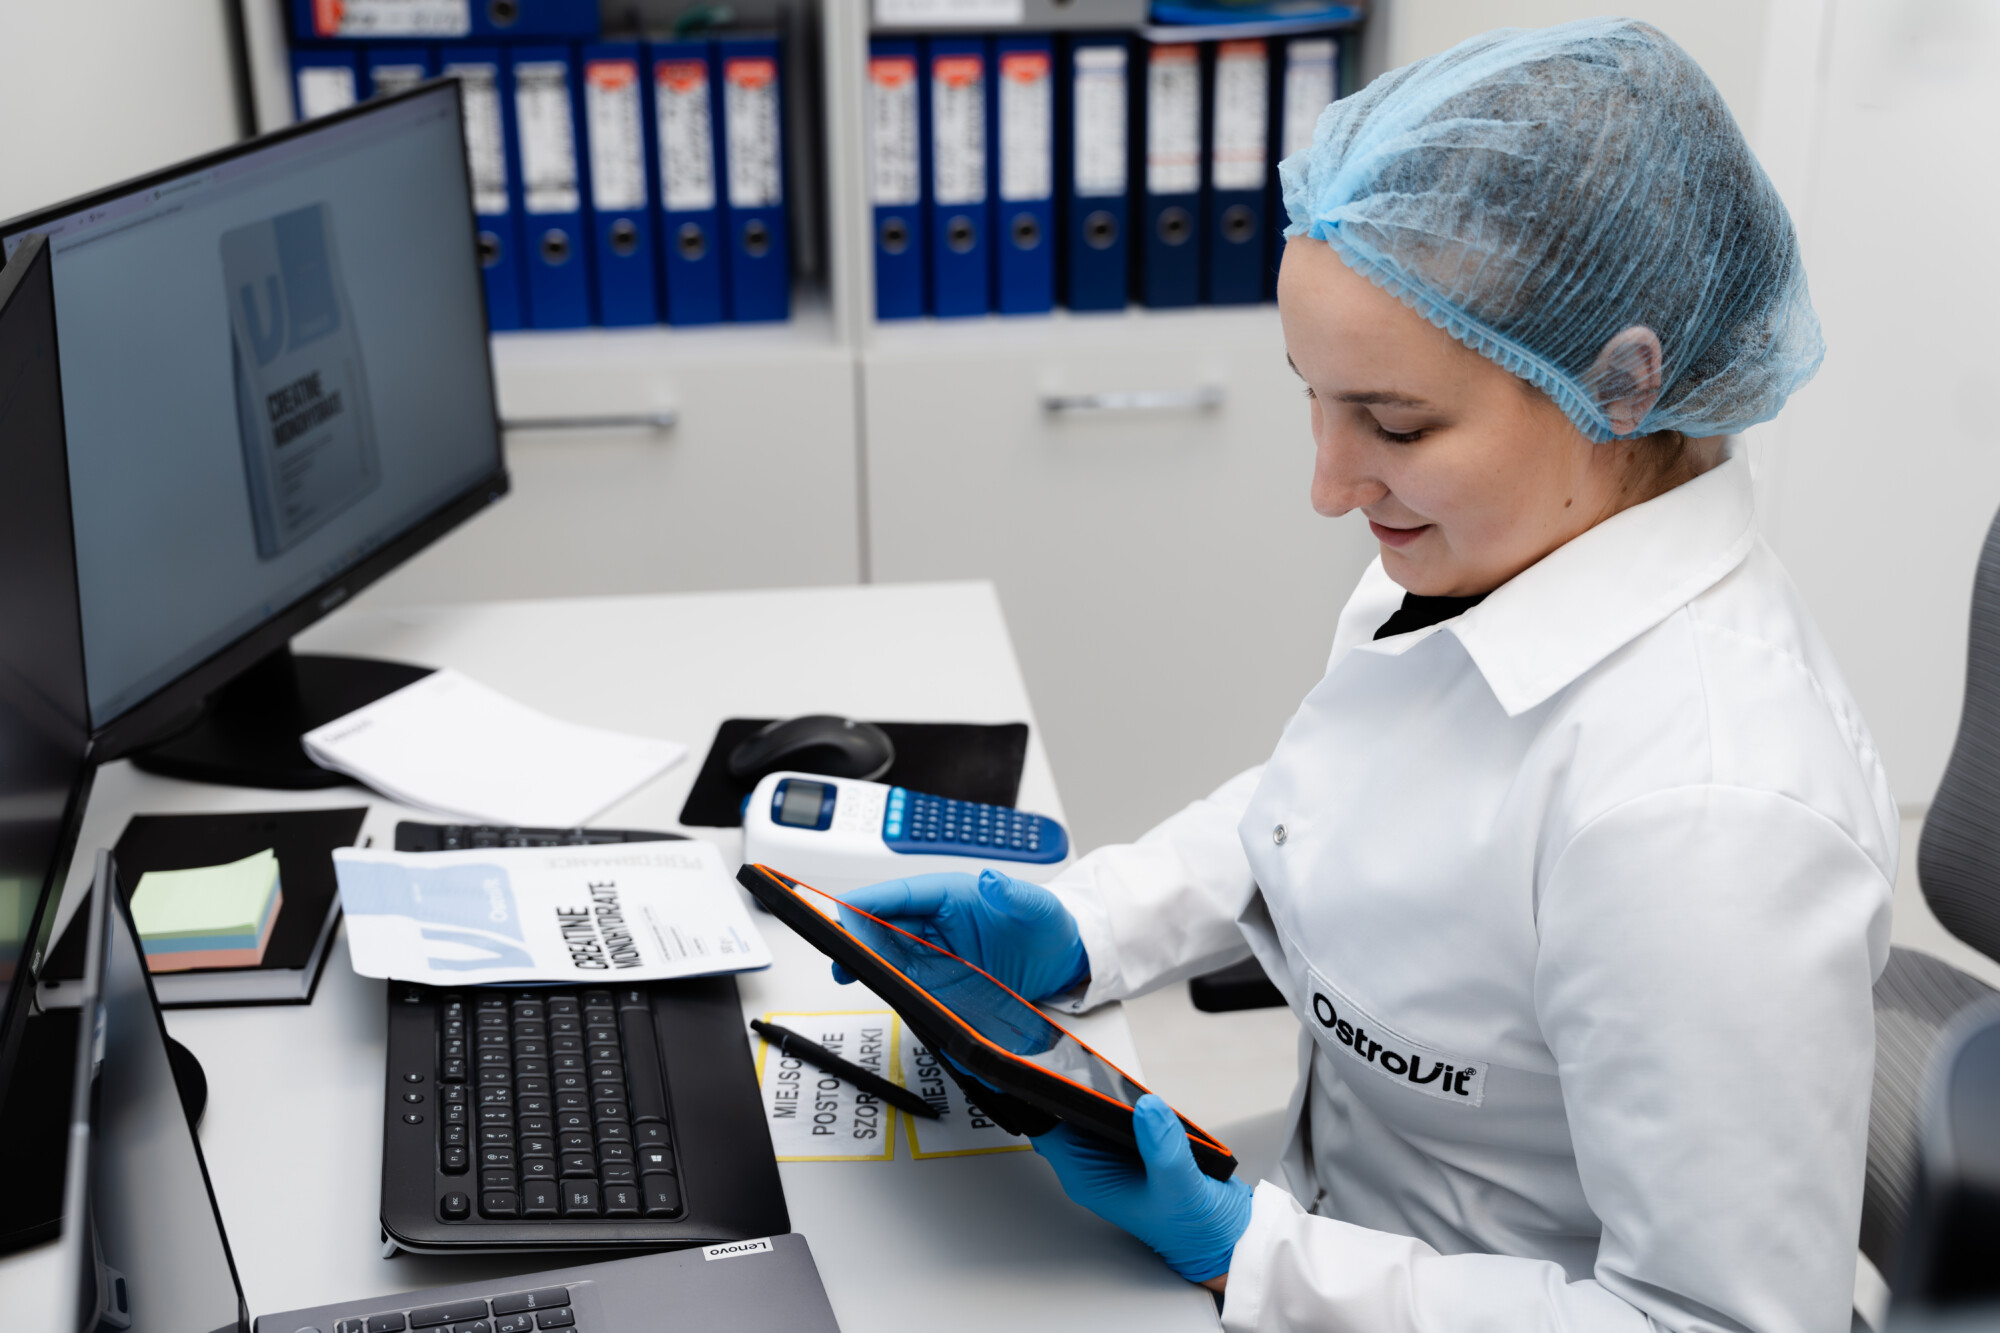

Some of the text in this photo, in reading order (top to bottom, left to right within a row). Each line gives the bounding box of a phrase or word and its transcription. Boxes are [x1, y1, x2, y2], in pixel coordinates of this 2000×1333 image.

[556, 906, 609, 970] CREATINE
[812, 1033, 844, 1135] POSTOWE
[709, 1242, 767, 1255] Lenovo
[528, 1294, 536, 1307] Enter
